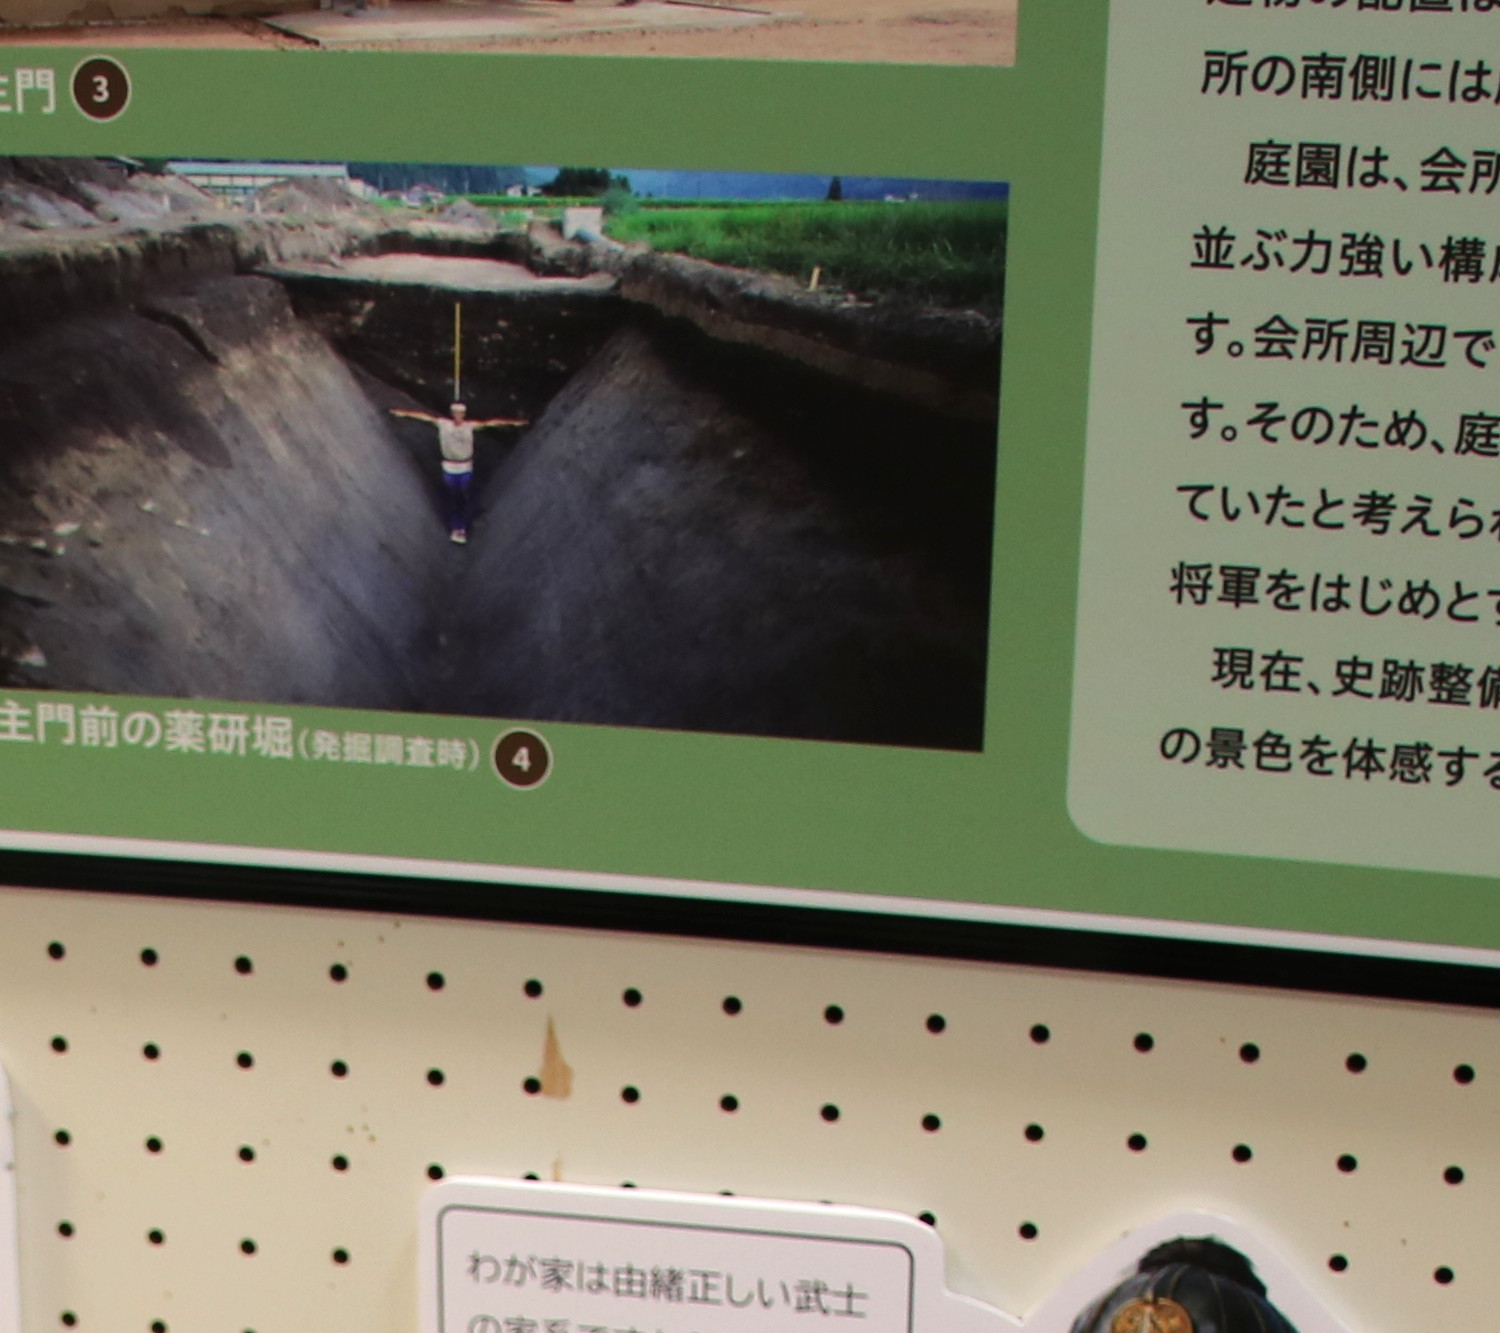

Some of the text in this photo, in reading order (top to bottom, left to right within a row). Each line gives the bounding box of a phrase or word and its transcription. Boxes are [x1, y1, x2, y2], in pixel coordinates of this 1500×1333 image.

[467, 1250, 869, 1319] わが家は由緒正しい武士
